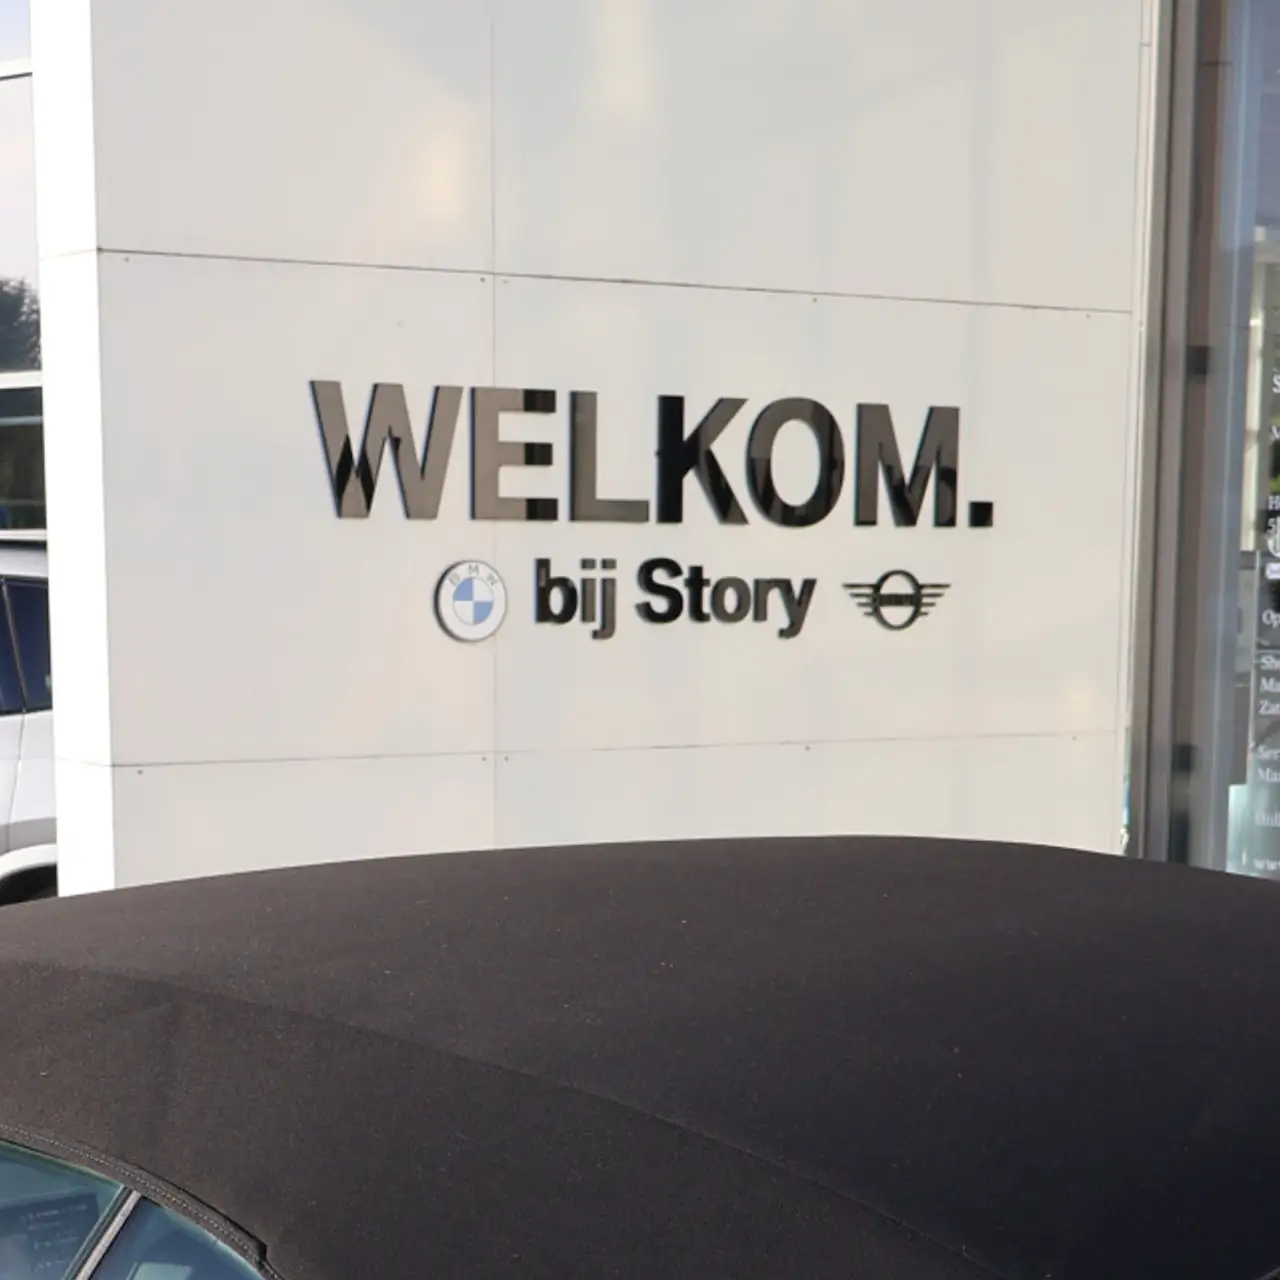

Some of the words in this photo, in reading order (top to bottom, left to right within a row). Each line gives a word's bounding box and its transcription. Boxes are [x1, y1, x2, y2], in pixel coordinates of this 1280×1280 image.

[308, 379, 994, 528] WELKOM.
[534, 557, 618, 640] bij
[634, 557, 818, 639] Story
